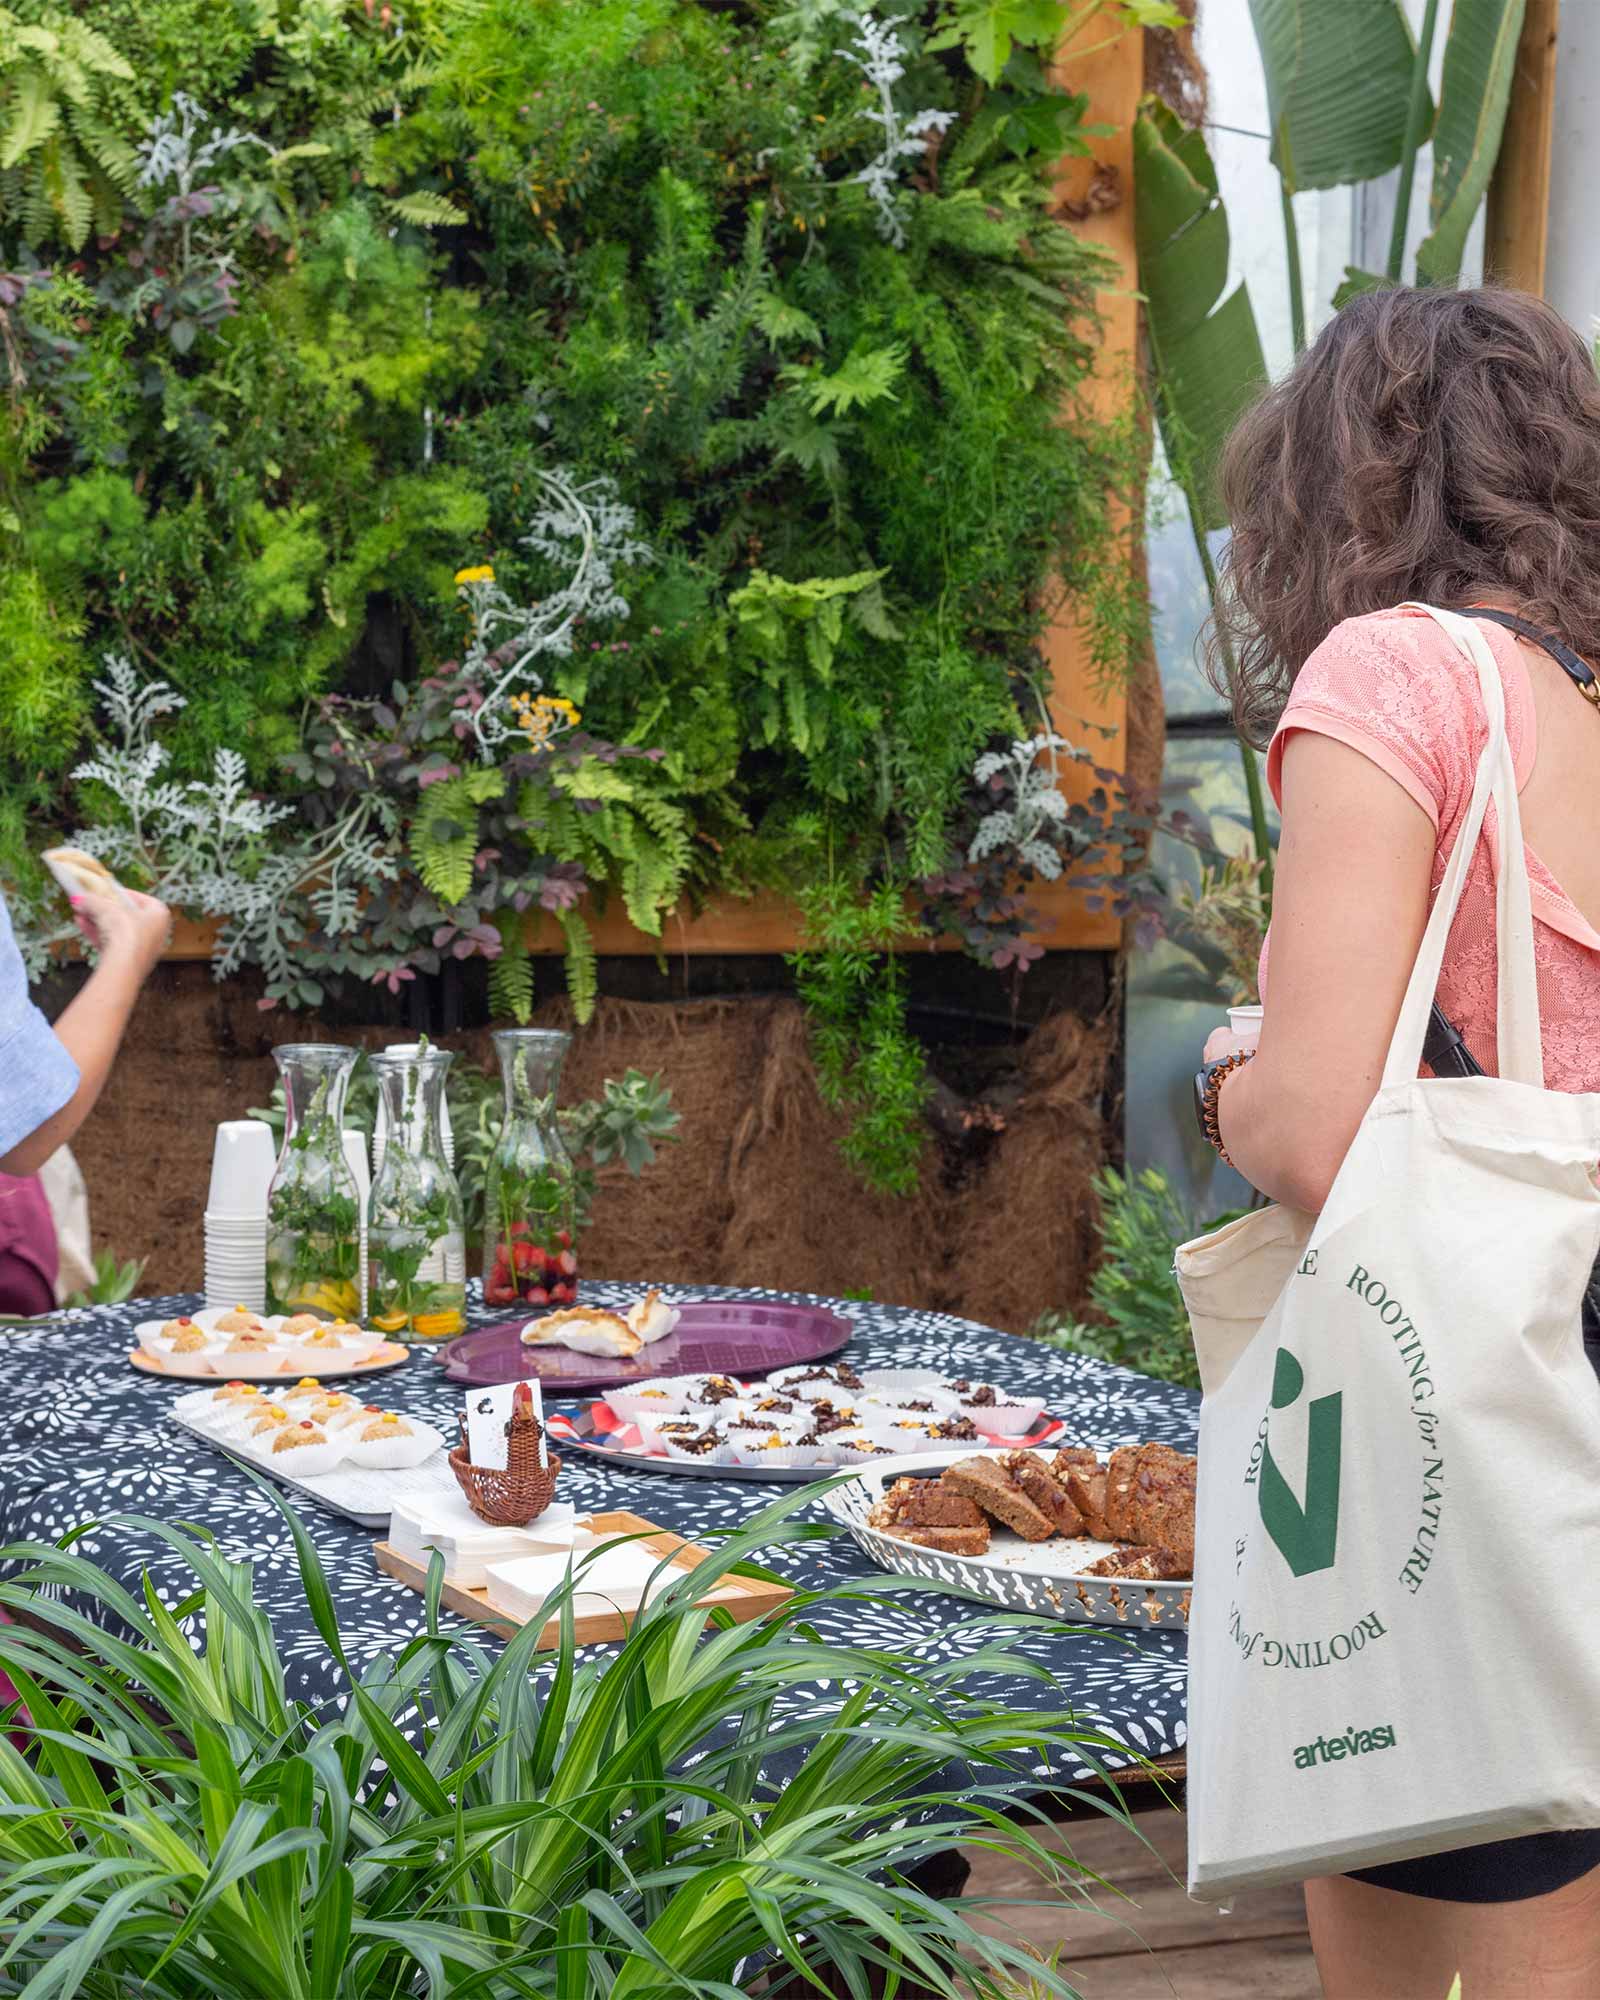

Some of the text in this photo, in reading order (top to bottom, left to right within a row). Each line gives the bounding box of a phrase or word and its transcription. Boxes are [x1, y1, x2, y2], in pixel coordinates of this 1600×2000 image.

[1346, 1264, 1444, 1595] ROOTING for NATURE
[1262, 1610, 1388, 1669] ROOTING
[1293, 1724, 1398, 1770] artevasi
